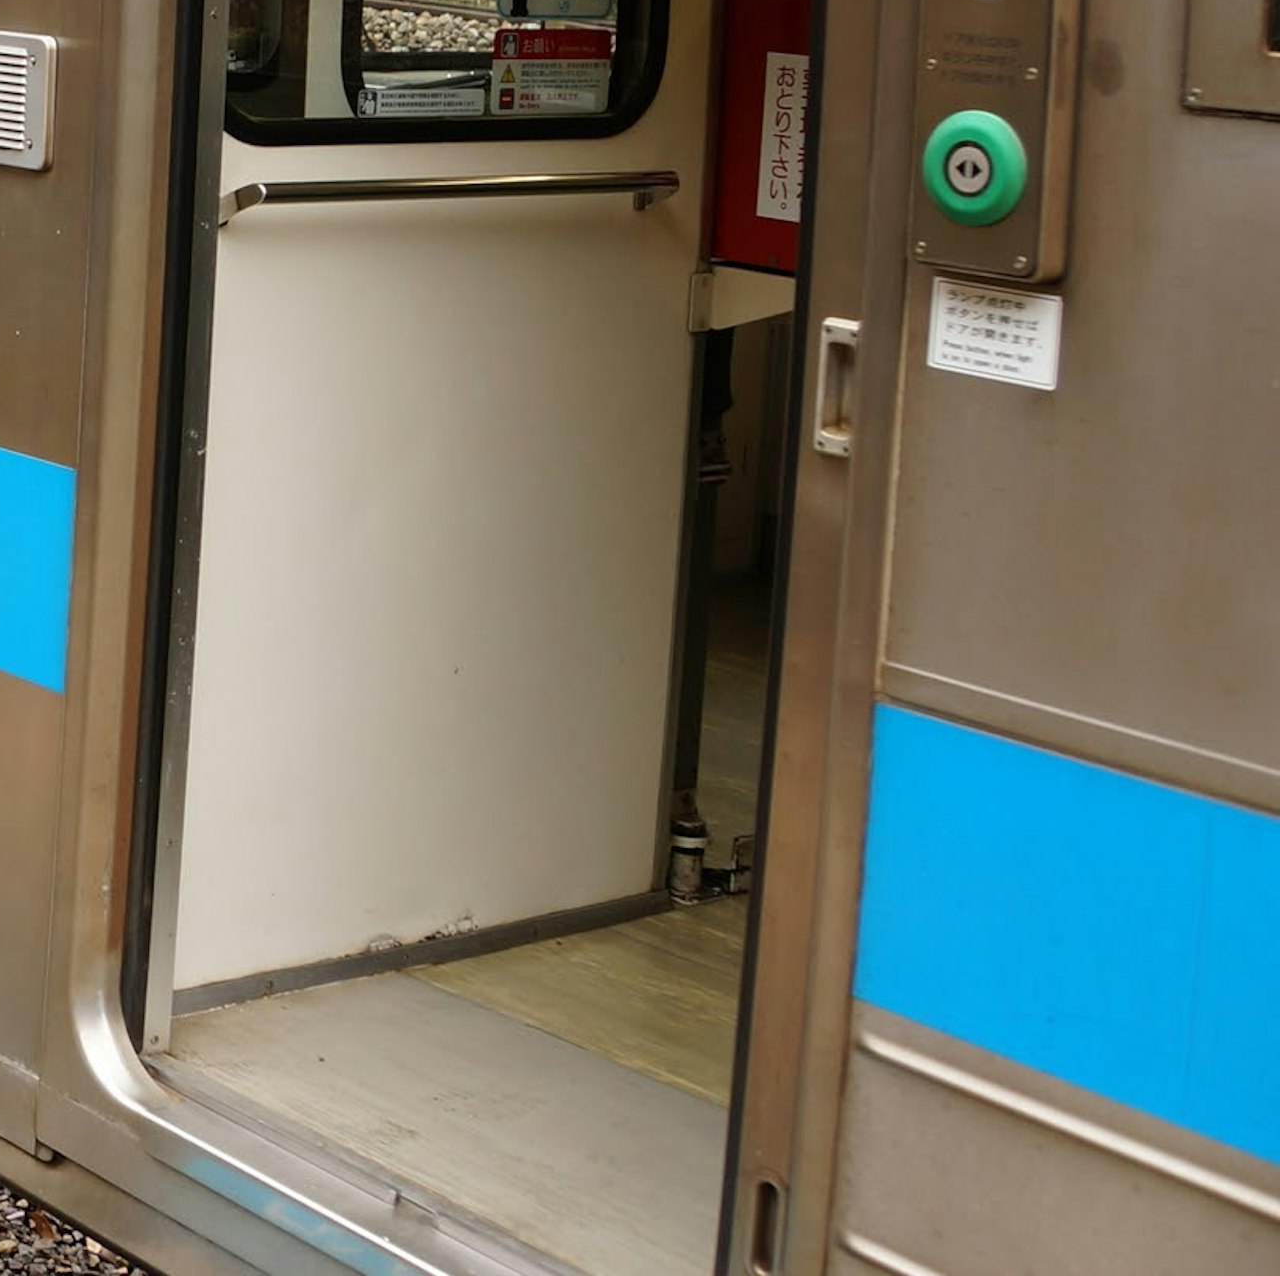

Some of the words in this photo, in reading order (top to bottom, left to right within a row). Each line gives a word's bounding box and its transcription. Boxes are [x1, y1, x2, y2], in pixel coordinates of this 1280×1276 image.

[770, 66, 795, 210] おとり下さい。
[946, 289, 1025, 312] ランプ点灯中
[944, 307, 1038, 331] ボタンを押せば
